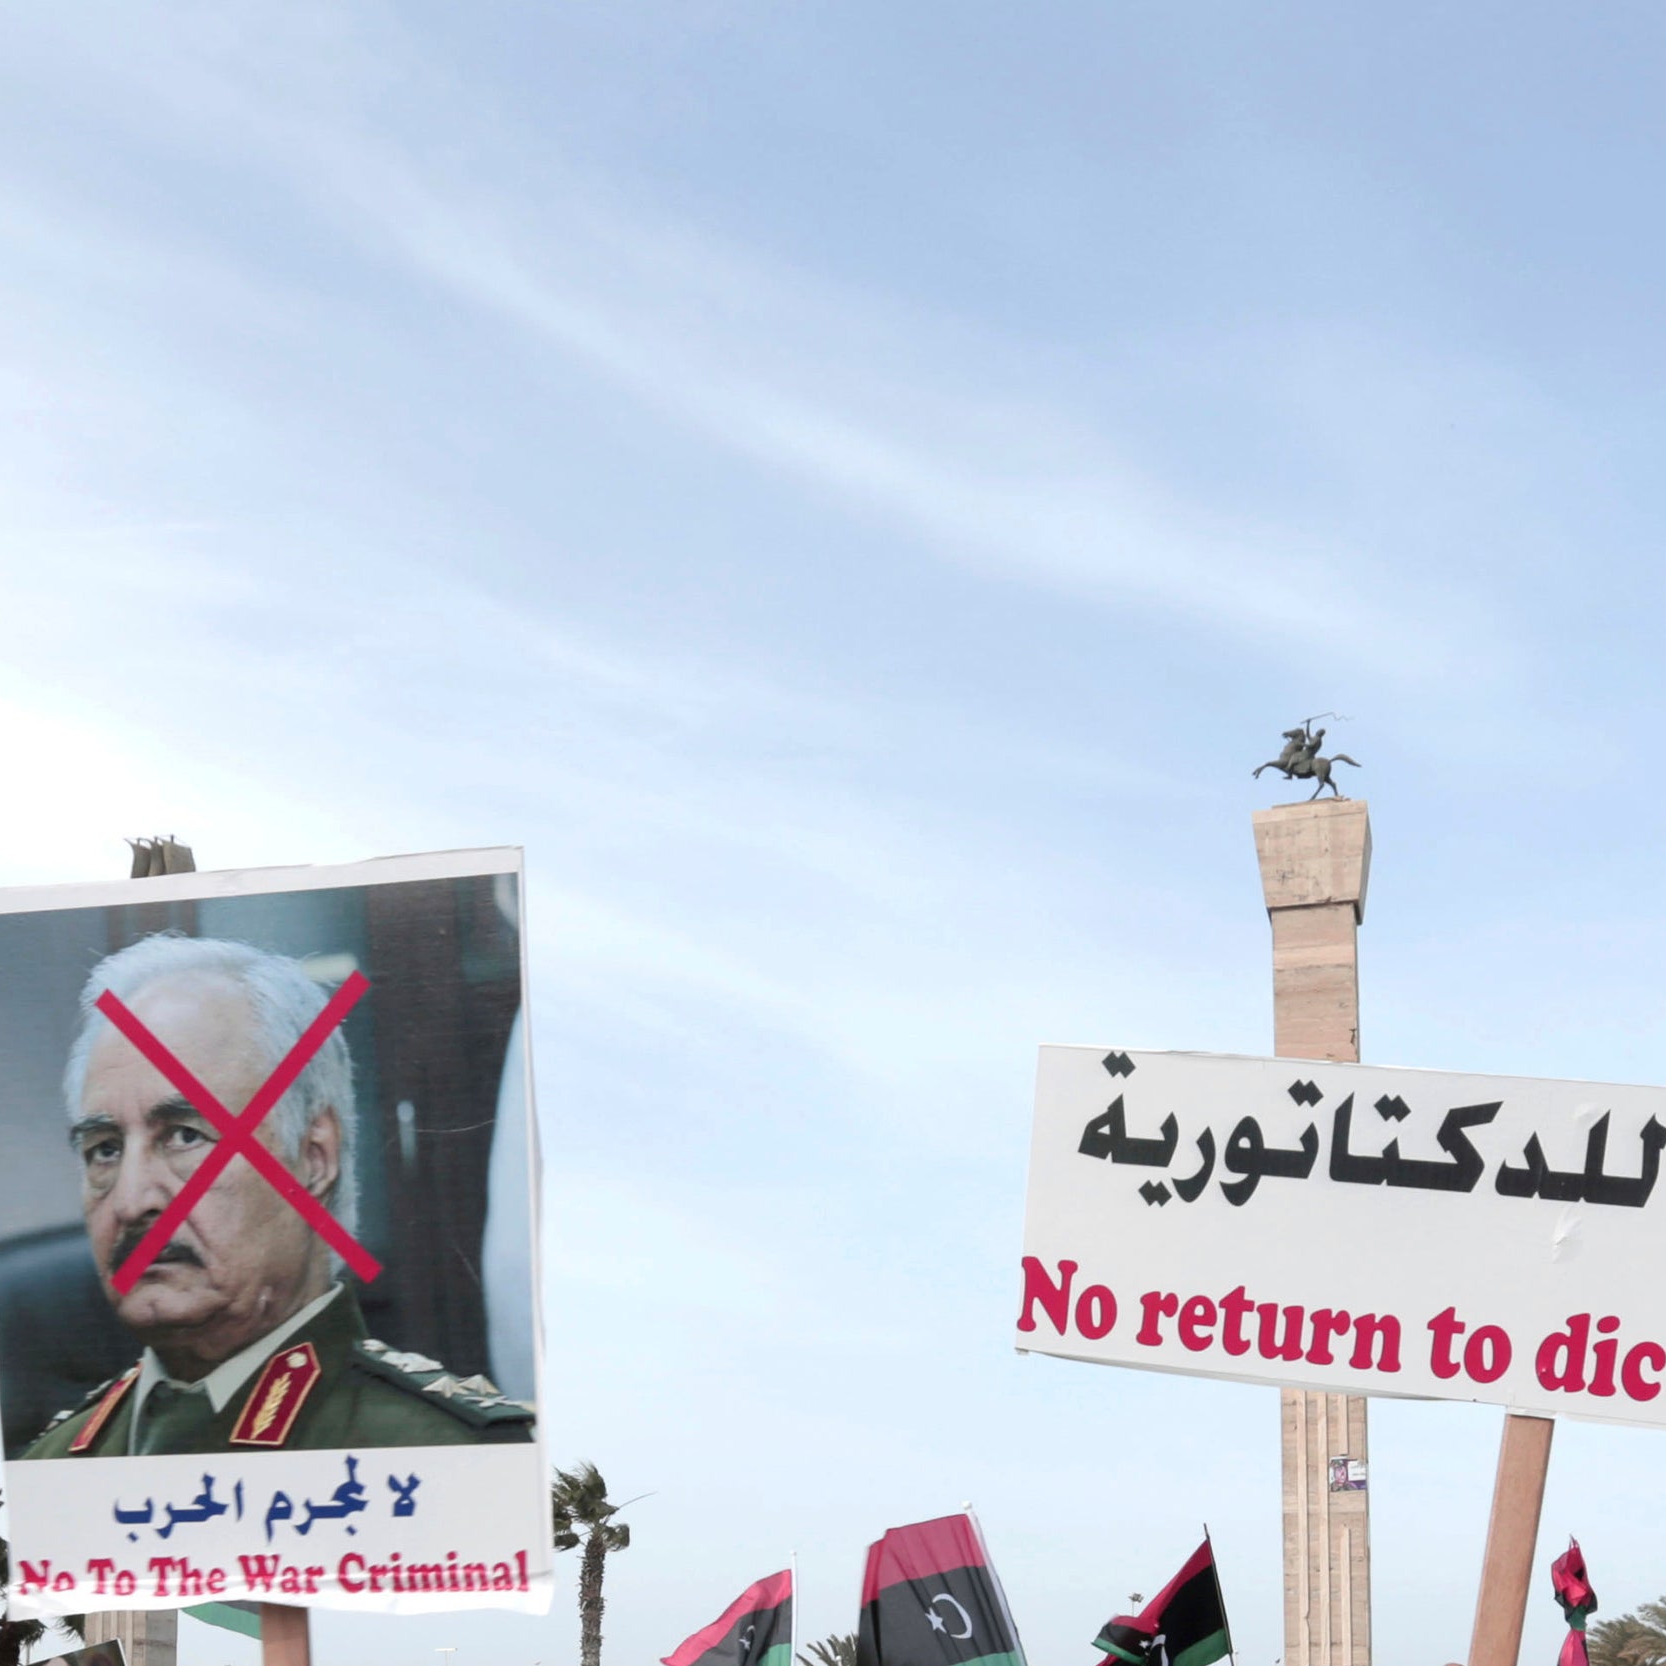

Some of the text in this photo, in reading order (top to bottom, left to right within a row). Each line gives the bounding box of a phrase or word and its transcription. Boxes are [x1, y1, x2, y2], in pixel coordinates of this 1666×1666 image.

[1017, 1256, 1118, 1340] No
[1136, 1286, 1402, 1374] return
[1427, 1306, 1513, 1385] to
[114, 1473, 244, 1542] الحرب
[387, 1472, 422, 1517] لا
[17, 1549, 530, 1598] No To The War Criminal
